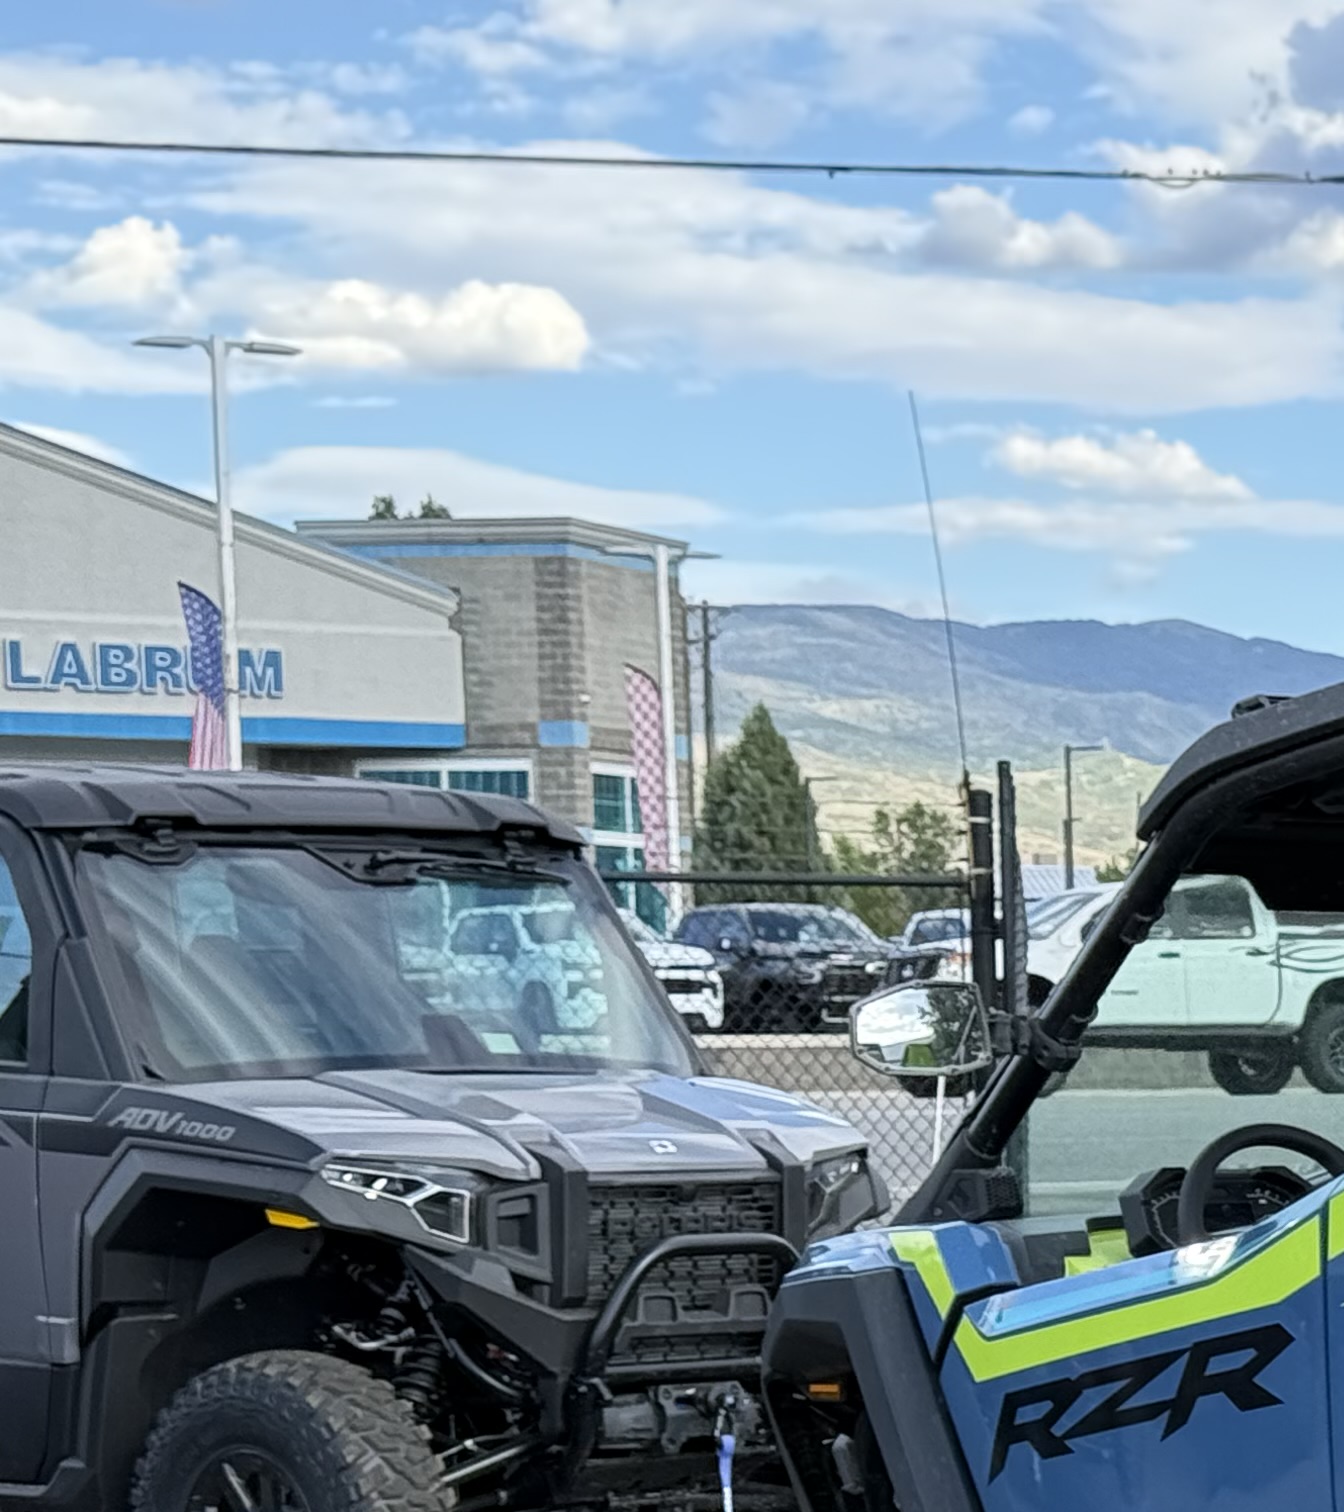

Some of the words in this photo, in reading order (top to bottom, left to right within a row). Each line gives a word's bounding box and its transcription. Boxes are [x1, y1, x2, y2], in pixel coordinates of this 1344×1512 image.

[5, 639, 284, 697] LABRM
[106, 1106, 186, 1133] ADV
[175, 1120, 237, 1141] 1000
[987, 1323, 1297, 1486] RZR
